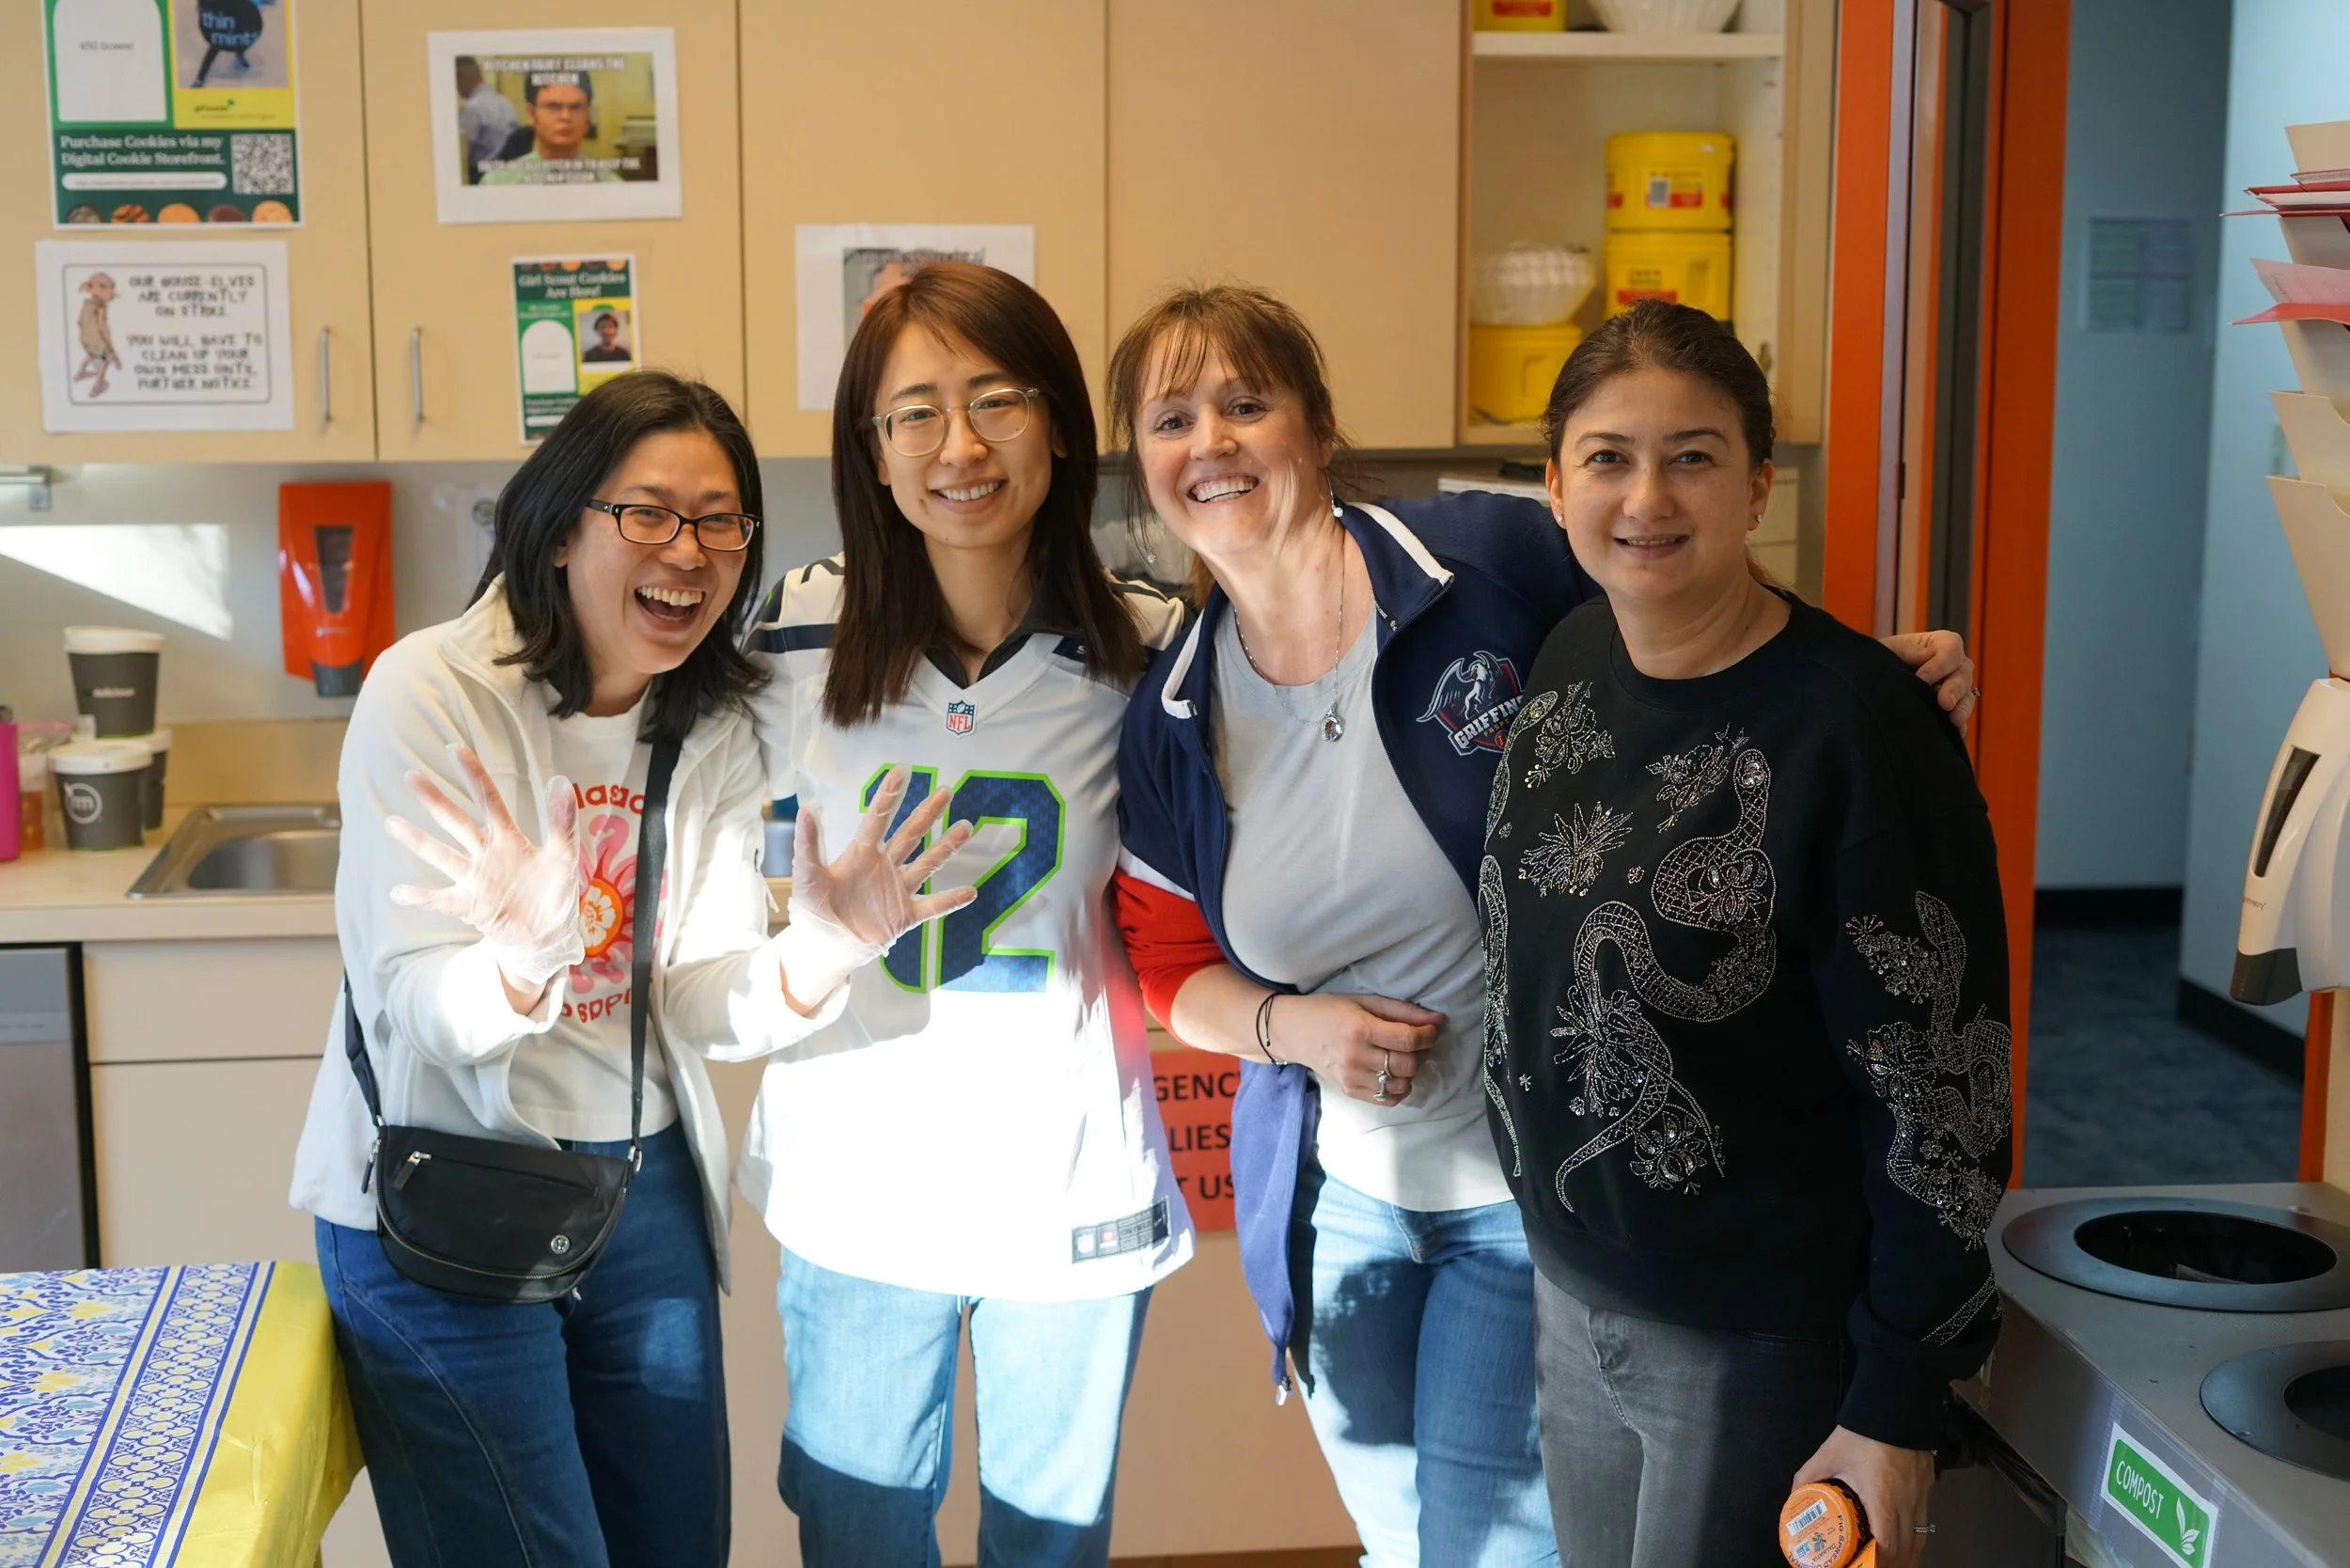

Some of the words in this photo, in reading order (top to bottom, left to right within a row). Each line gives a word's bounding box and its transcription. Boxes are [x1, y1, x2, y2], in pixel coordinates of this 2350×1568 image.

[201, 8, 235, 30] thin
[59, 134, 122, 149] Purchase
[124, 134, 177, 149] Cookies
[179, 134, 199, 148] via
[201, 137, 224, 151] my
[61, 152, 105, 168] Digital
[107, 151, 152, 165] Cookie
[129, 275, 154, 287] OUR
[211, 274, 255, 287] ELVES
[518, 274, 542, 288] Girl
[543, 273, 577, 287] Scout
[578, 271, 627, 285] Cookies
[138, 290, 161, 303] ARE
[167, 288, 247, 304] CURRENTLY
[545, 288, 568, 299] Are
[155, 306, 175, 318] ON
[127, 334, 153, 347] YOU
[159, 334, 194, 347] WILL
[200, 334, 235, 346] HAVE
[244, 332, 263, 346] TO
[142, 349, 187, 361] CLEAN
[193, 349, 209, 360] UP
[216, 349, 248, 360] YOUR
[133, 364, 165, 375] OWN
[172, 364, 208, 375] MESS
[948, 714, 971, 730] NFL
[859, 762, 1066, 994] 12
[1153, 1072, 1240, 1102] GENC
[2116, 1460, 2164, 1519] COMPOST
[1824, 1534, 1845, 1568] SPREAD
